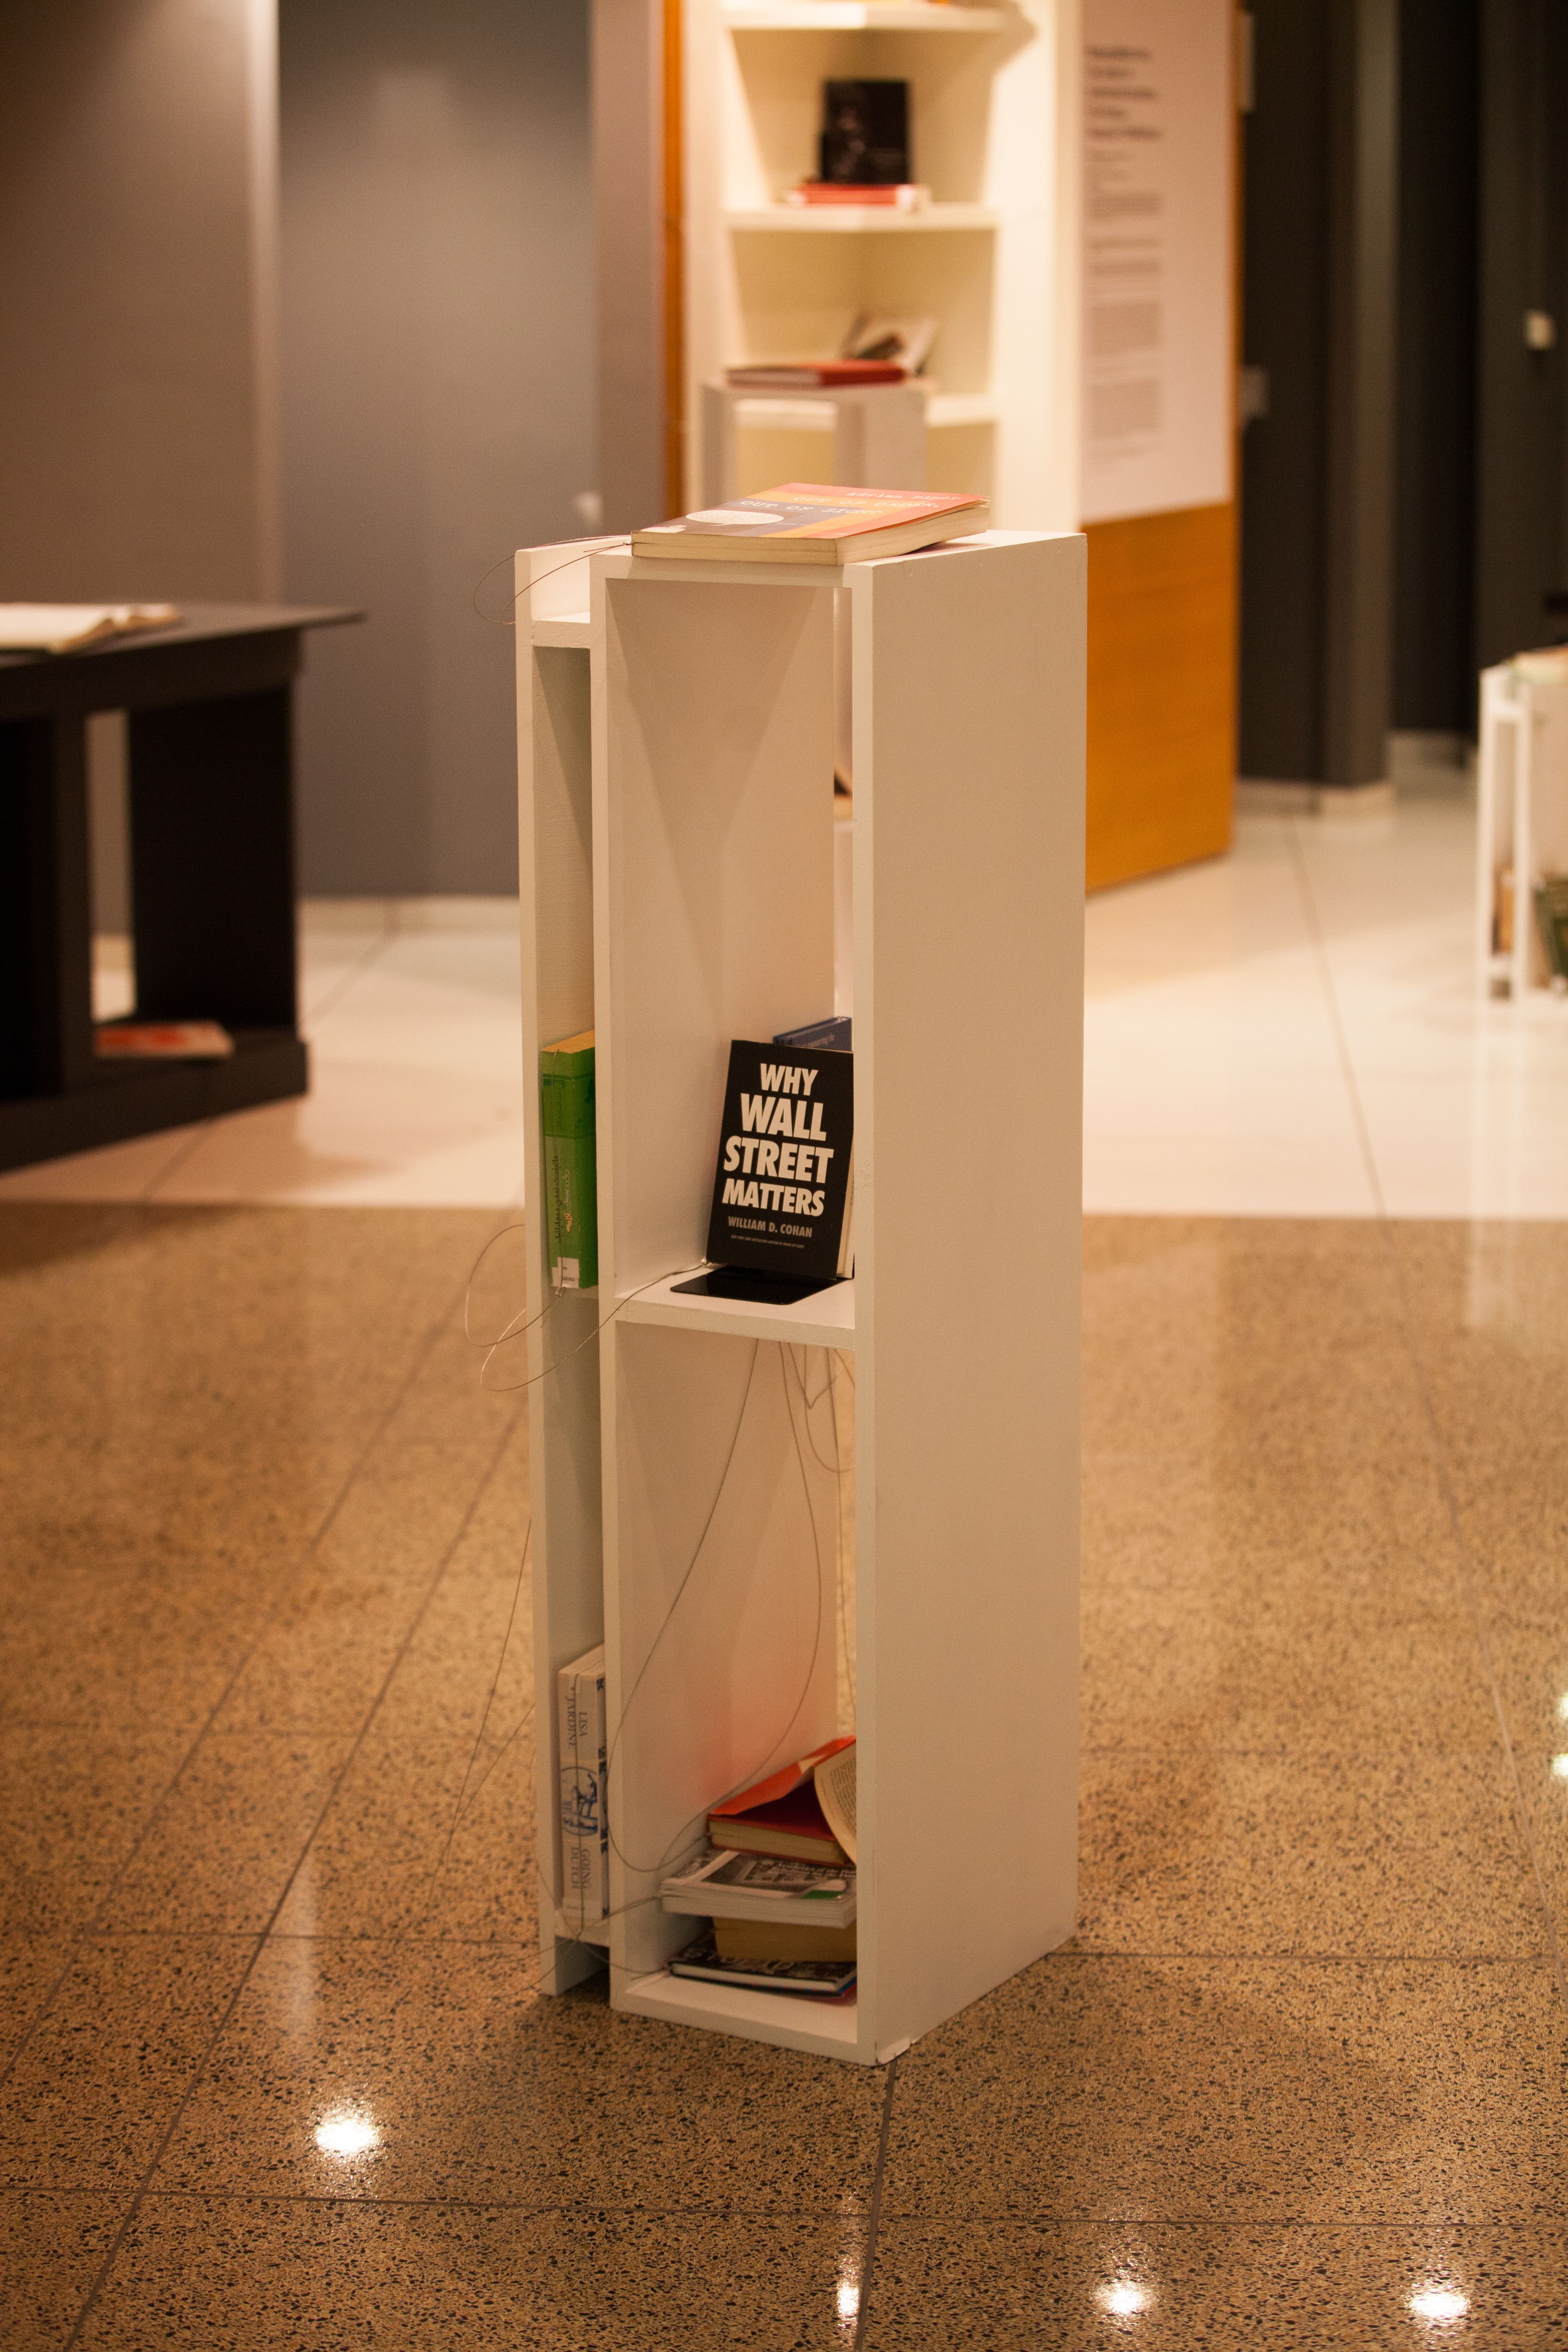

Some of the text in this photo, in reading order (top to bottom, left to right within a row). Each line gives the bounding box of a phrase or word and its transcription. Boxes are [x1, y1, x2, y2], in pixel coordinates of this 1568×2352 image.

[761, 1063, 818, 1096] WHY
[741, 1093, 826, 1141] WALL
[724, 1136, 834, 1184] STREET
[722, 1178, 825, 1216] MATTERS
[728, 1216, 813, 1238] WILLIAM D. COHAN
[579, 1711, 588, 1737] LISA
[581, 1848, 591, 1889] GOING
